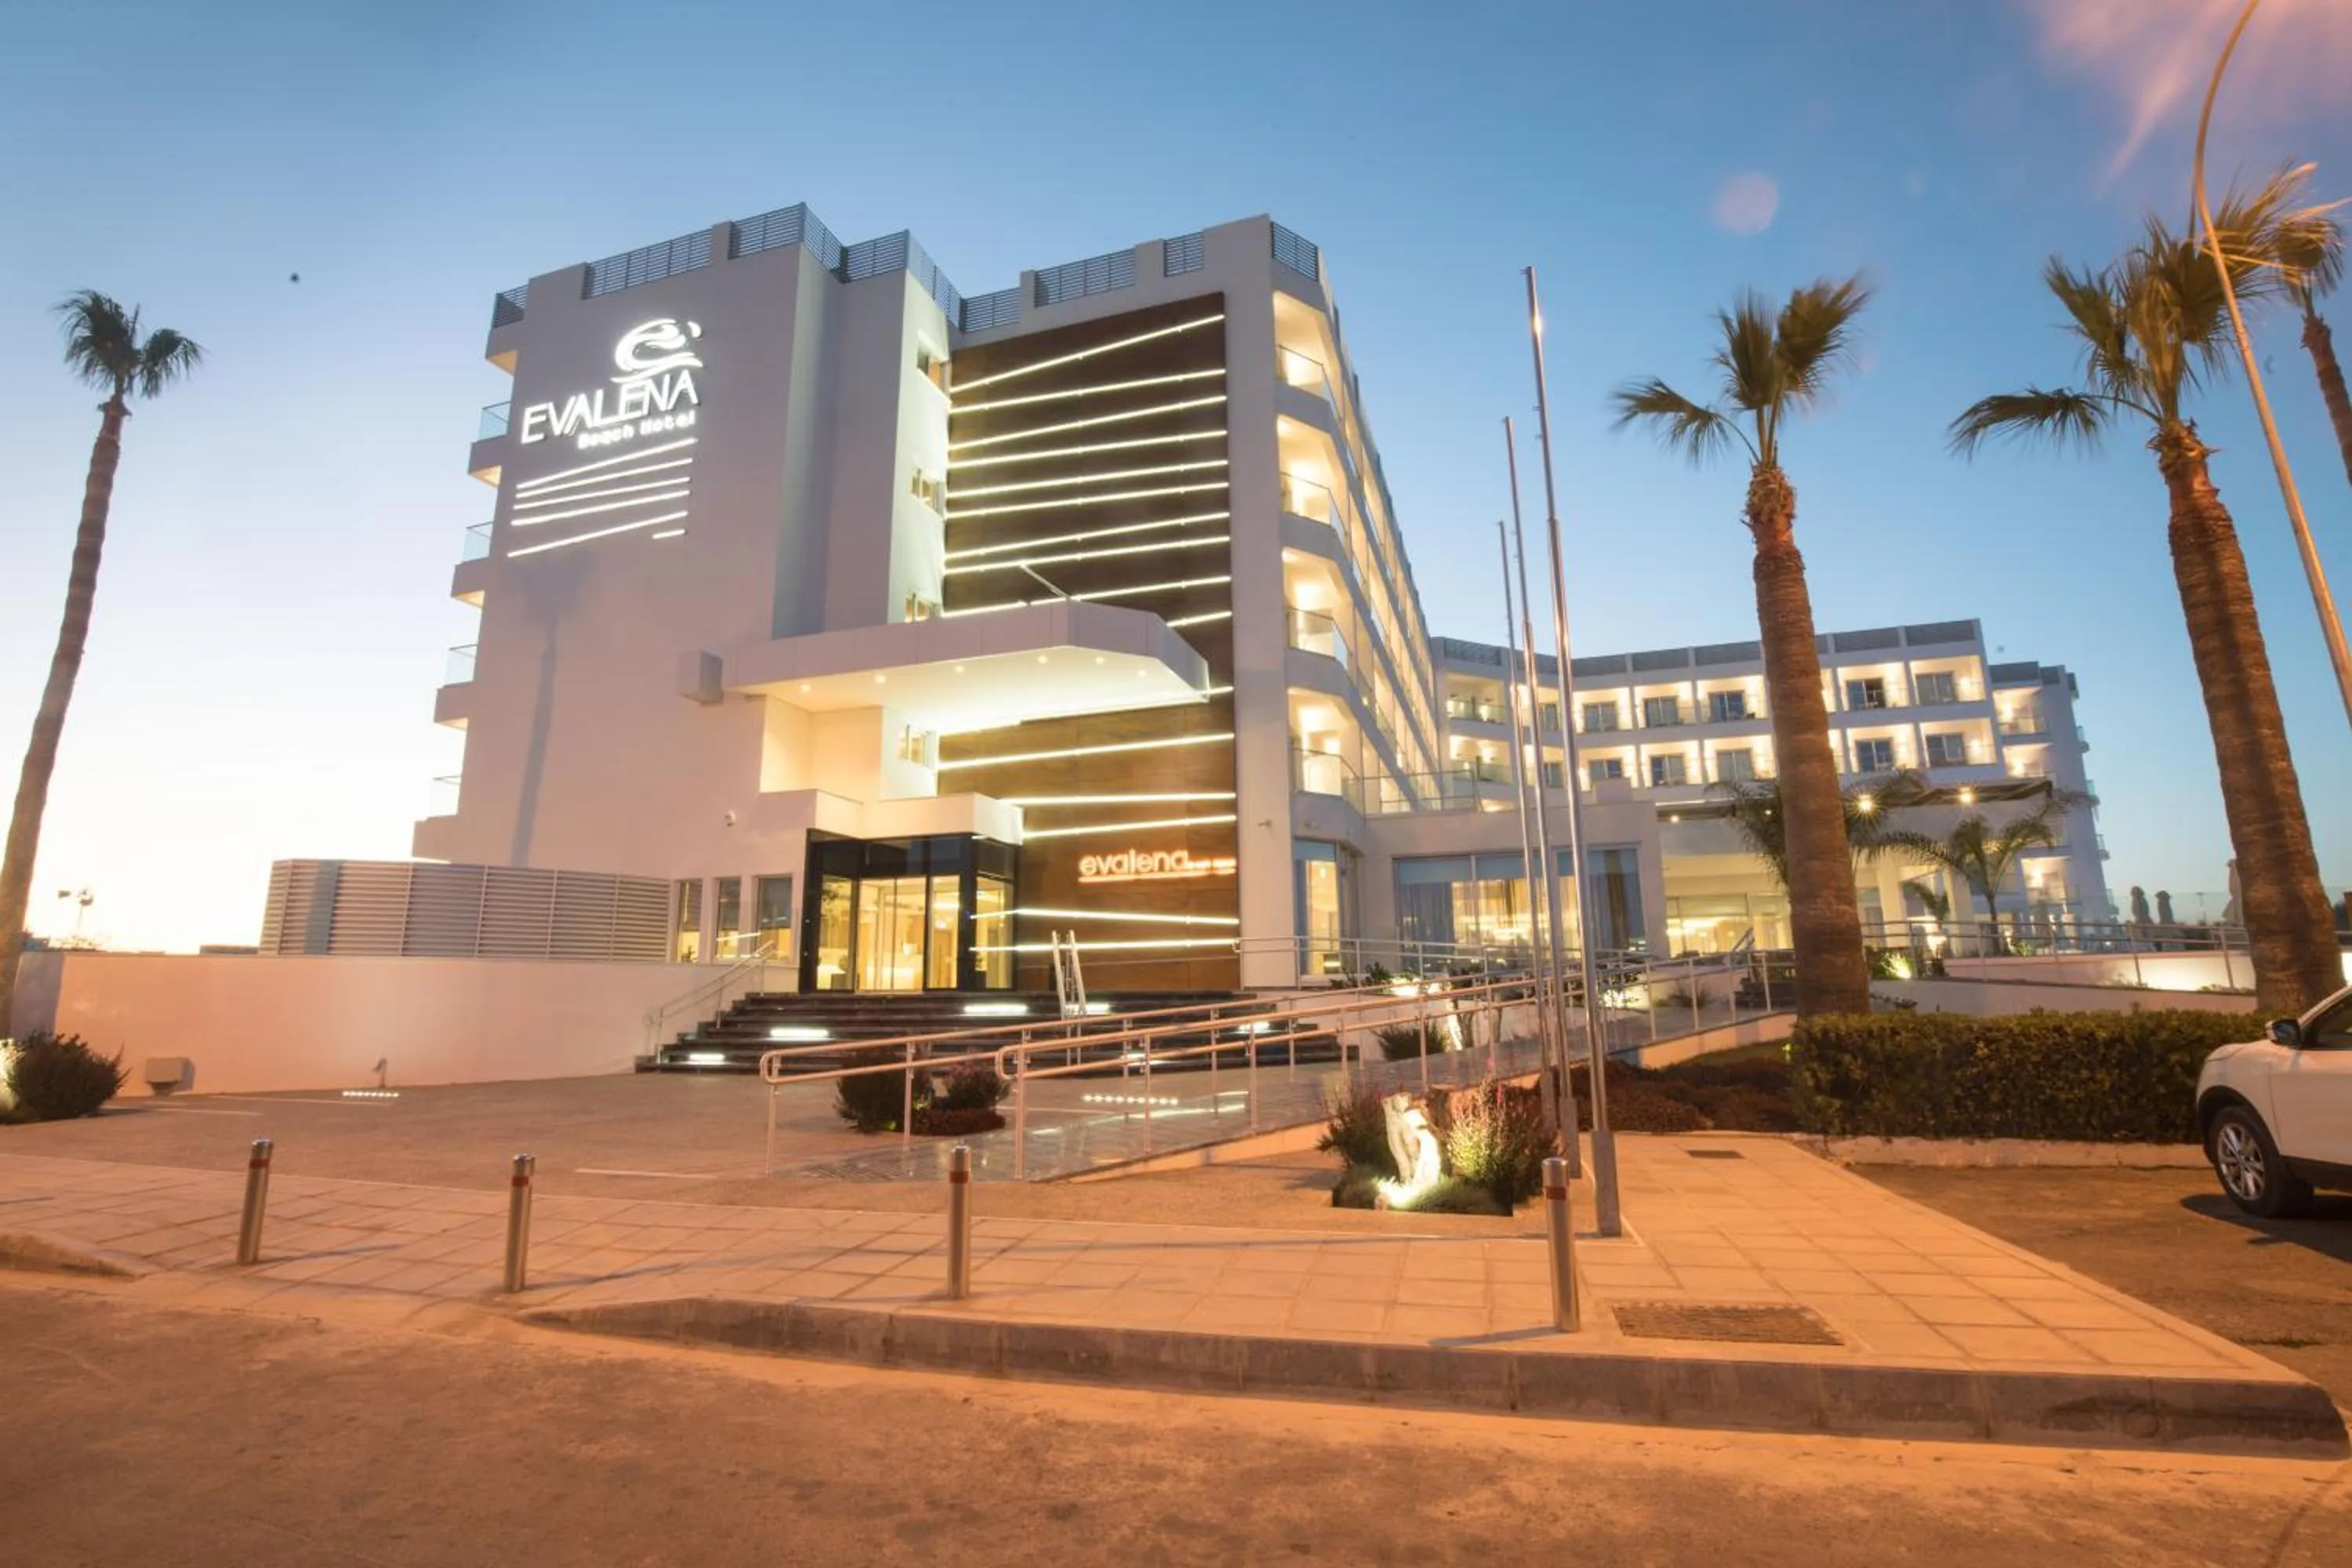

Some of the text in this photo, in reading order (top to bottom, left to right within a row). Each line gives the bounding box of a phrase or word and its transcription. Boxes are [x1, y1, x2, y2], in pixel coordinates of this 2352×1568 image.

[521, 369, 699, 444] EVALENA
[640, 410, 695, 436] Hotel
[1079, 848, 1189, 876] evalena
